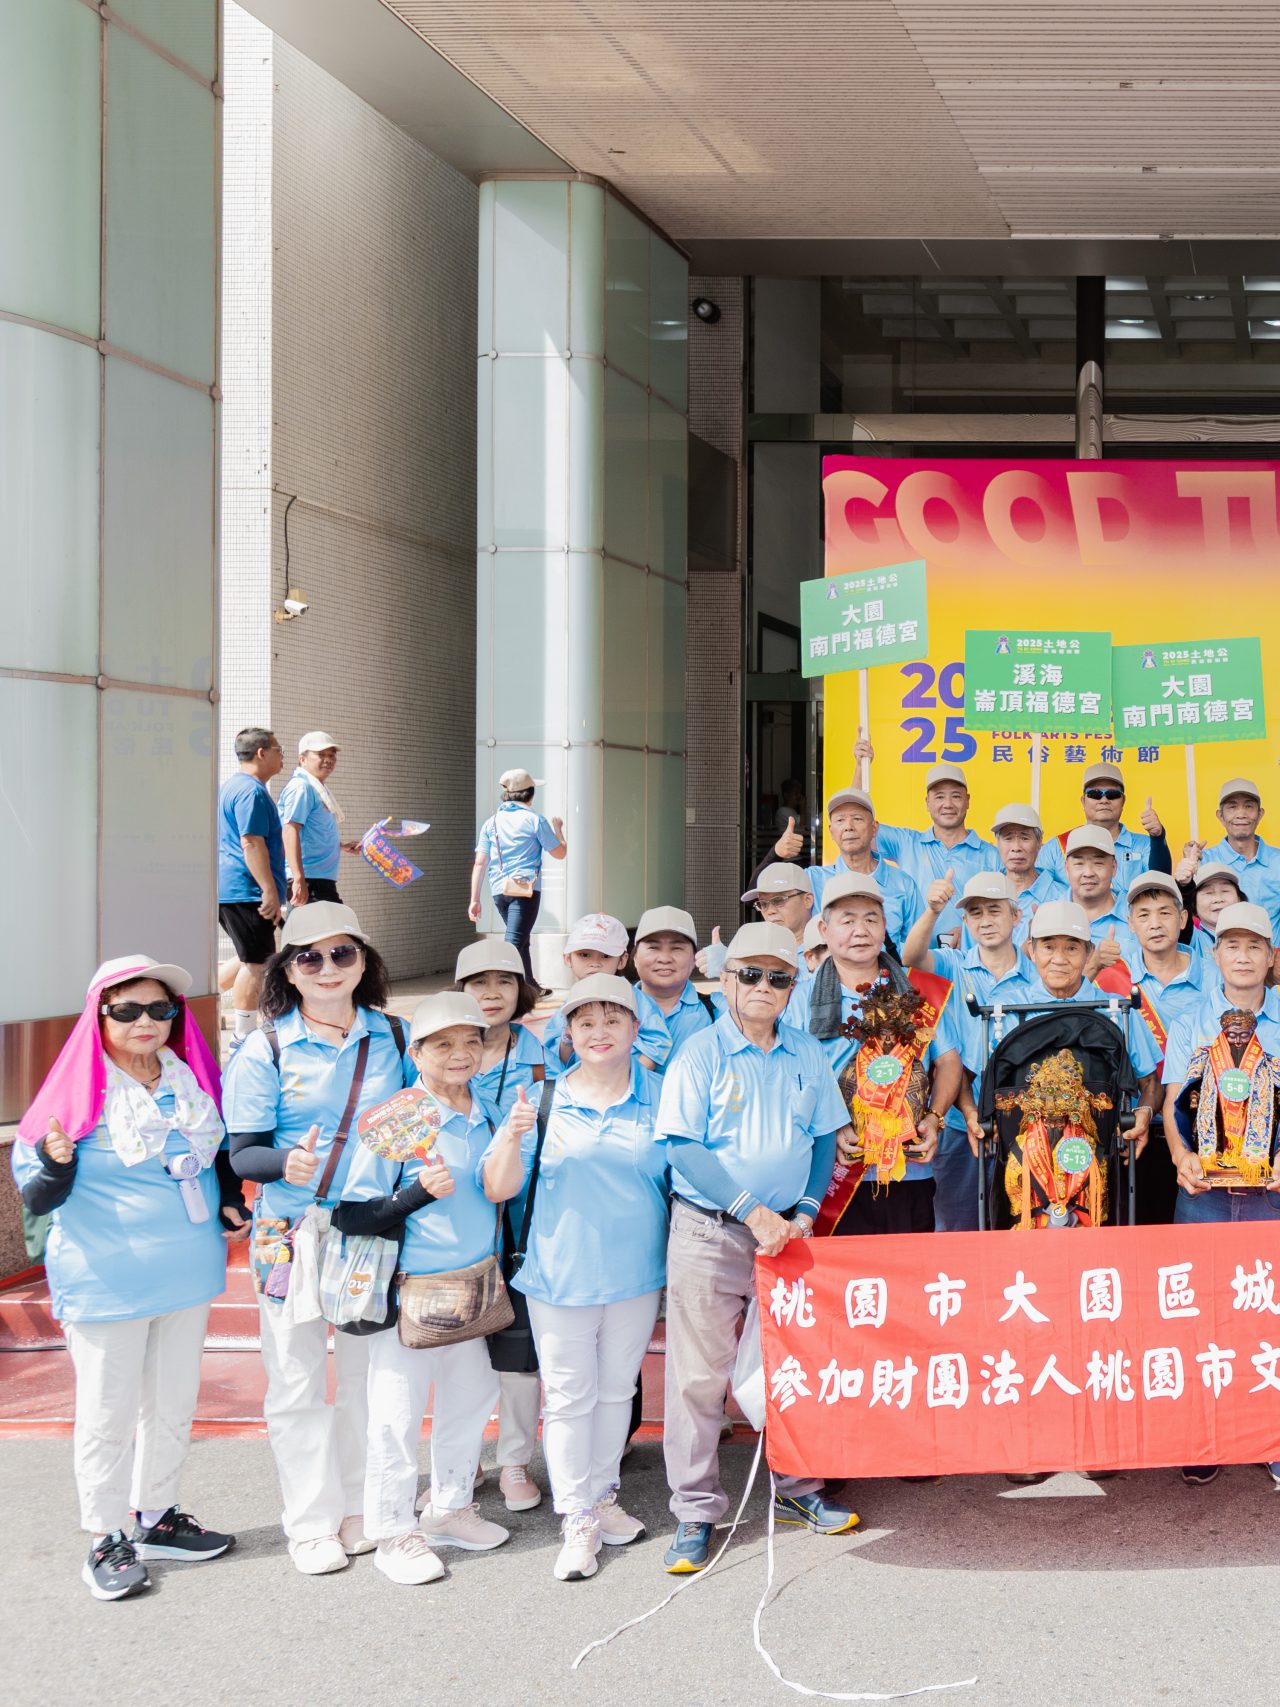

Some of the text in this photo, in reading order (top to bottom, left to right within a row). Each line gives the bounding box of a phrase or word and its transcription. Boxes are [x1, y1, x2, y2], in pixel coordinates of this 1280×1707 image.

[822, 469, 1153, 567] GOOD
[841, 600, 884, 627] 大園
[809, 620, 918, 658] 南門福德宮
[1013, 663, 1063, 687] 溪海
[1161, 674, 1213, 698] 大園
[974, 689, 1101, 715] 崙頂福德宮
[1122, 698, 1254, 729] 南門南德宮
[900, 717, 978, 763] 25
[992, 745, 1160, 763] 民俗藝術節
[876, 1068, 893, 1078] 2-1
[1063, 1153, 1087, 1165] 5-13
